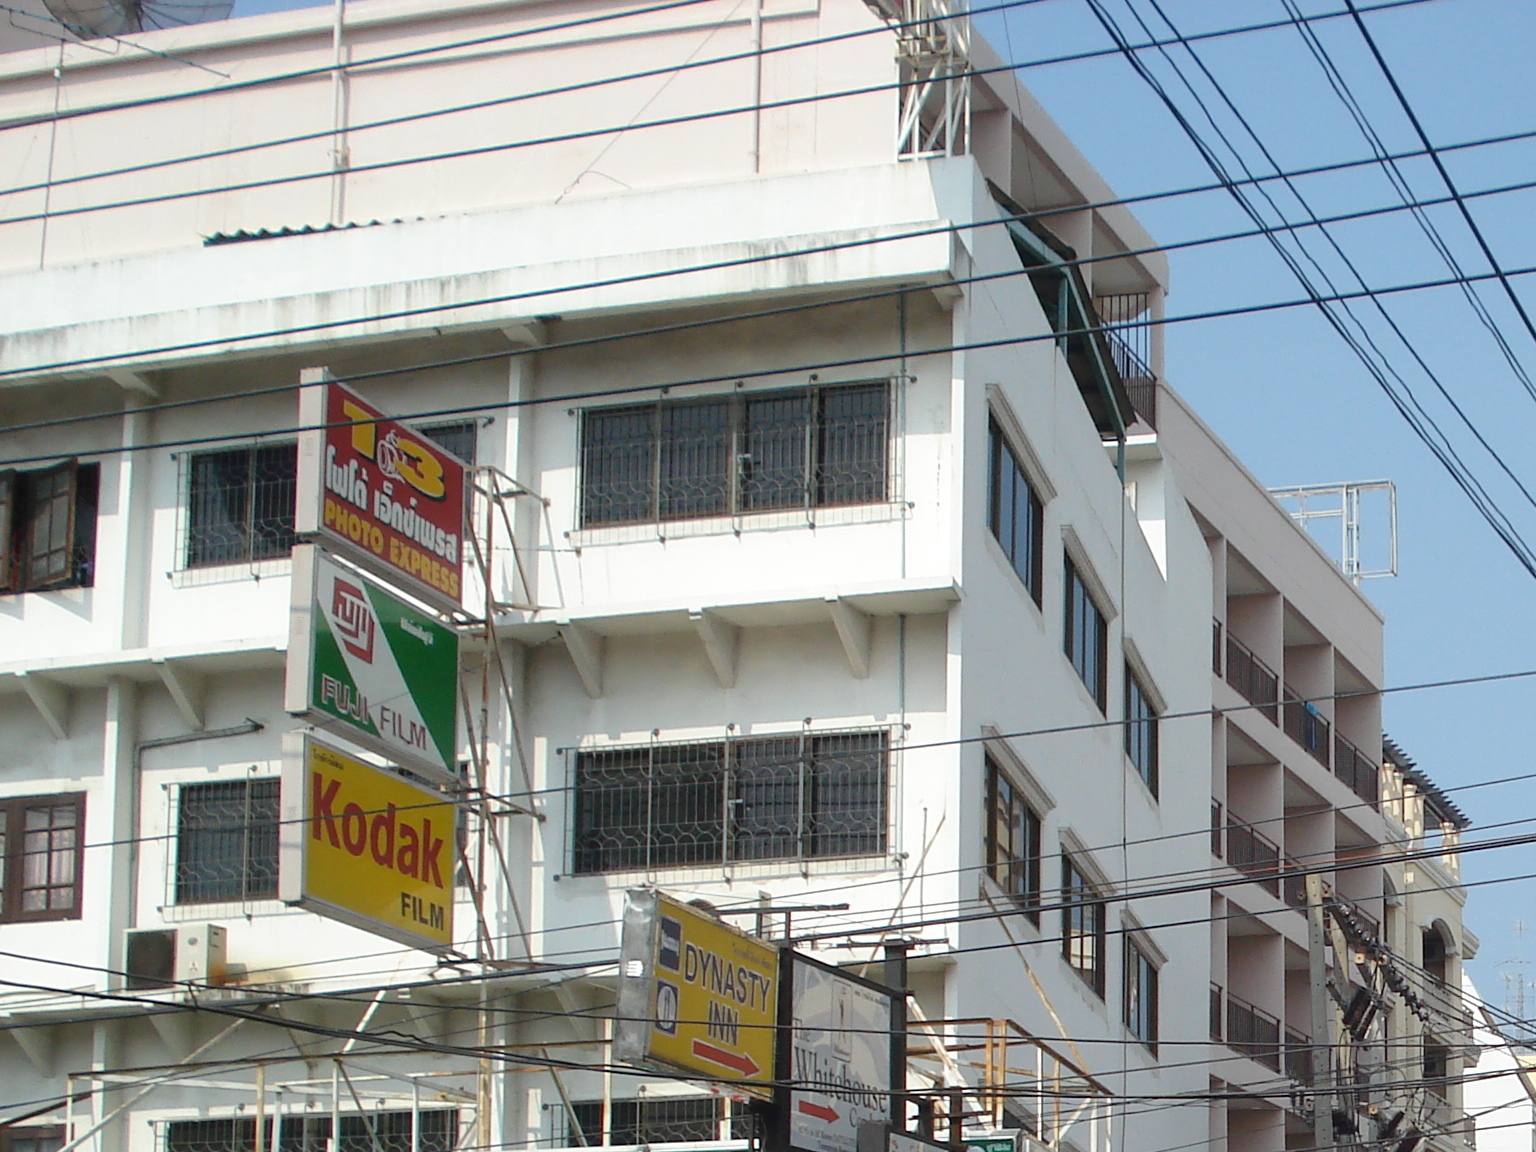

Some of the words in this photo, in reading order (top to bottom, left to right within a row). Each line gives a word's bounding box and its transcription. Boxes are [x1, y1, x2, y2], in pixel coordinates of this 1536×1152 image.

[343, 399, 446, 500] 13
[324, 498, 384, 555] PHOTO
[389, 536, 459, 598] EXPRESS
[321, 673, 369, 725] FUJI
[380, 705, 427, 751] FILM
[312, 771, 444, 890] Kodak
[401, 891, 444, 931] FILM
[684, 941, 772, 1013] DYNASTY
[707, 1000, 739, 1047] INN
[793, 1017, 811, 1043] The
[793, 1045, 888, 1114] Whitehouse
